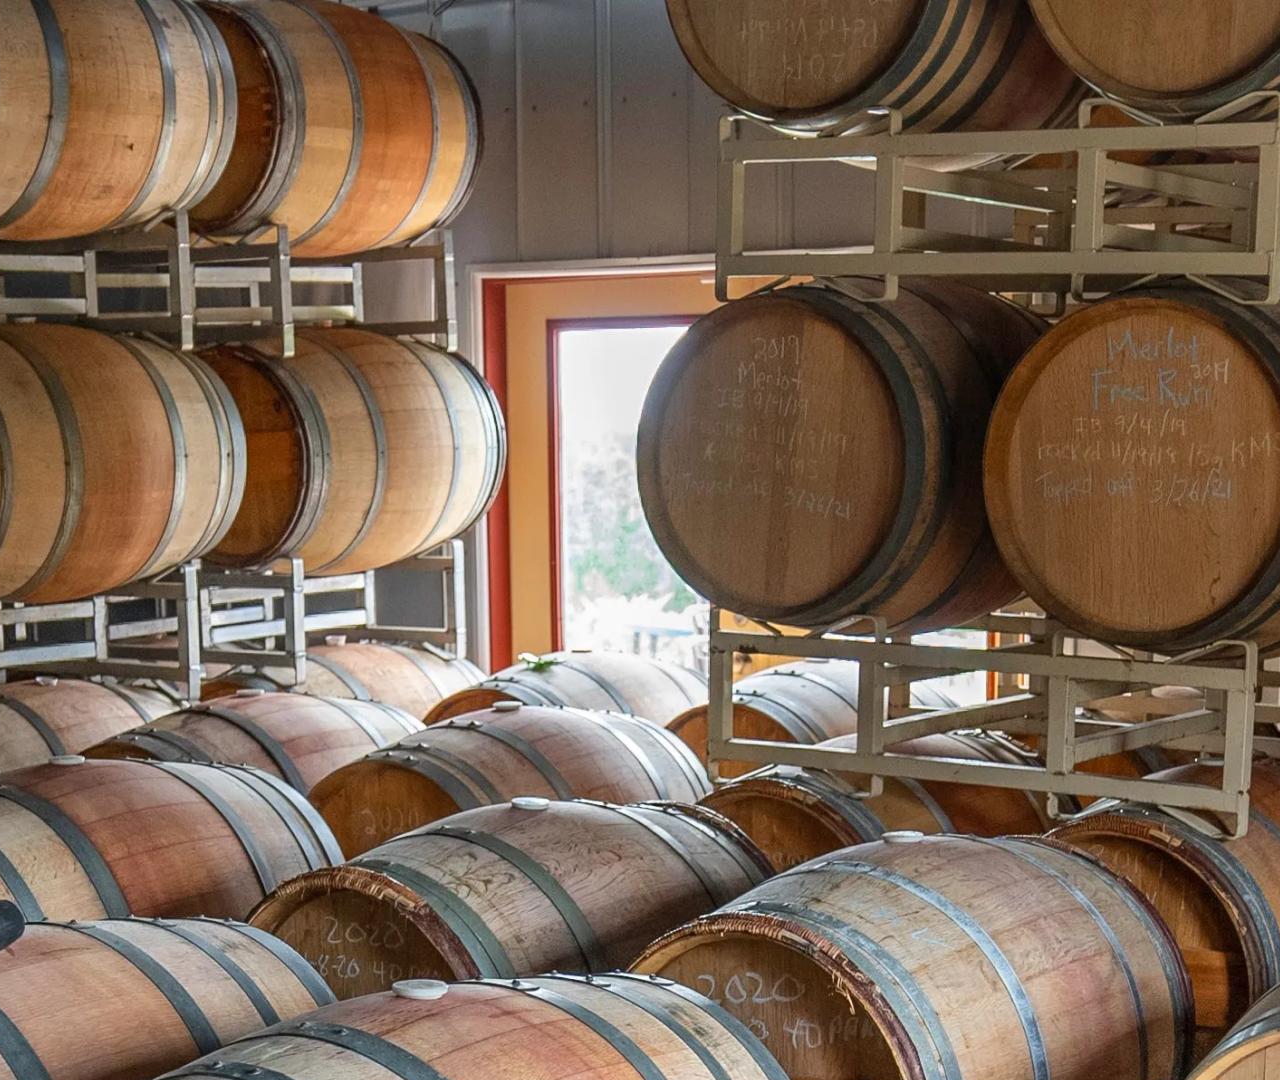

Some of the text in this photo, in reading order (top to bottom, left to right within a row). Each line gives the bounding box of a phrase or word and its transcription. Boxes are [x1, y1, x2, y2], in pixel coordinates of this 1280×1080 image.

[751, 334, 801, 365] 2019
[1108, 326, 1198, 365] Merlot
[737, 360, 803, 391] Merlot
[1090, 367, 1150, 411] Free
[1114, 408, 1188, 438] 9/4/19
[323, 915, 405, 949] 2020
[696, 971, 806, 1003] 2020
